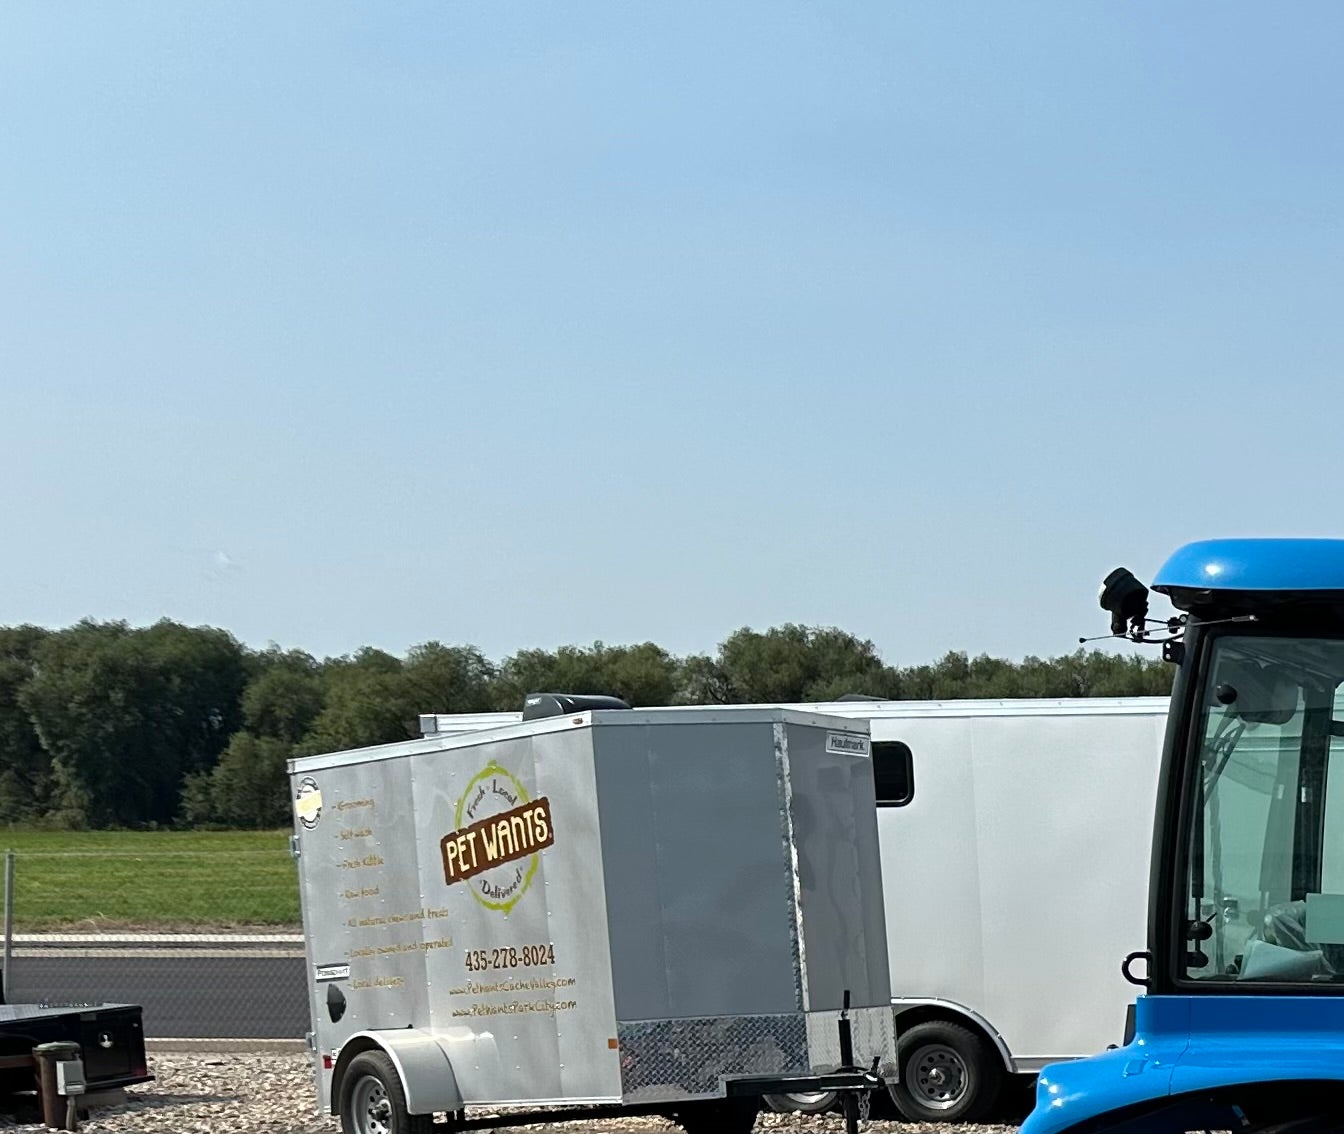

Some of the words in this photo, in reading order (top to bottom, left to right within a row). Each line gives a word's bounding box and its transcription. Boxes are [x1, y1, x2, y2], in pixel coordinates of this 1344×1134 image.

[446, 831, 478, 877] PET
[481, 807, 549, 862] WANTS
[465, 944, 556, 972] 435-278-8024
